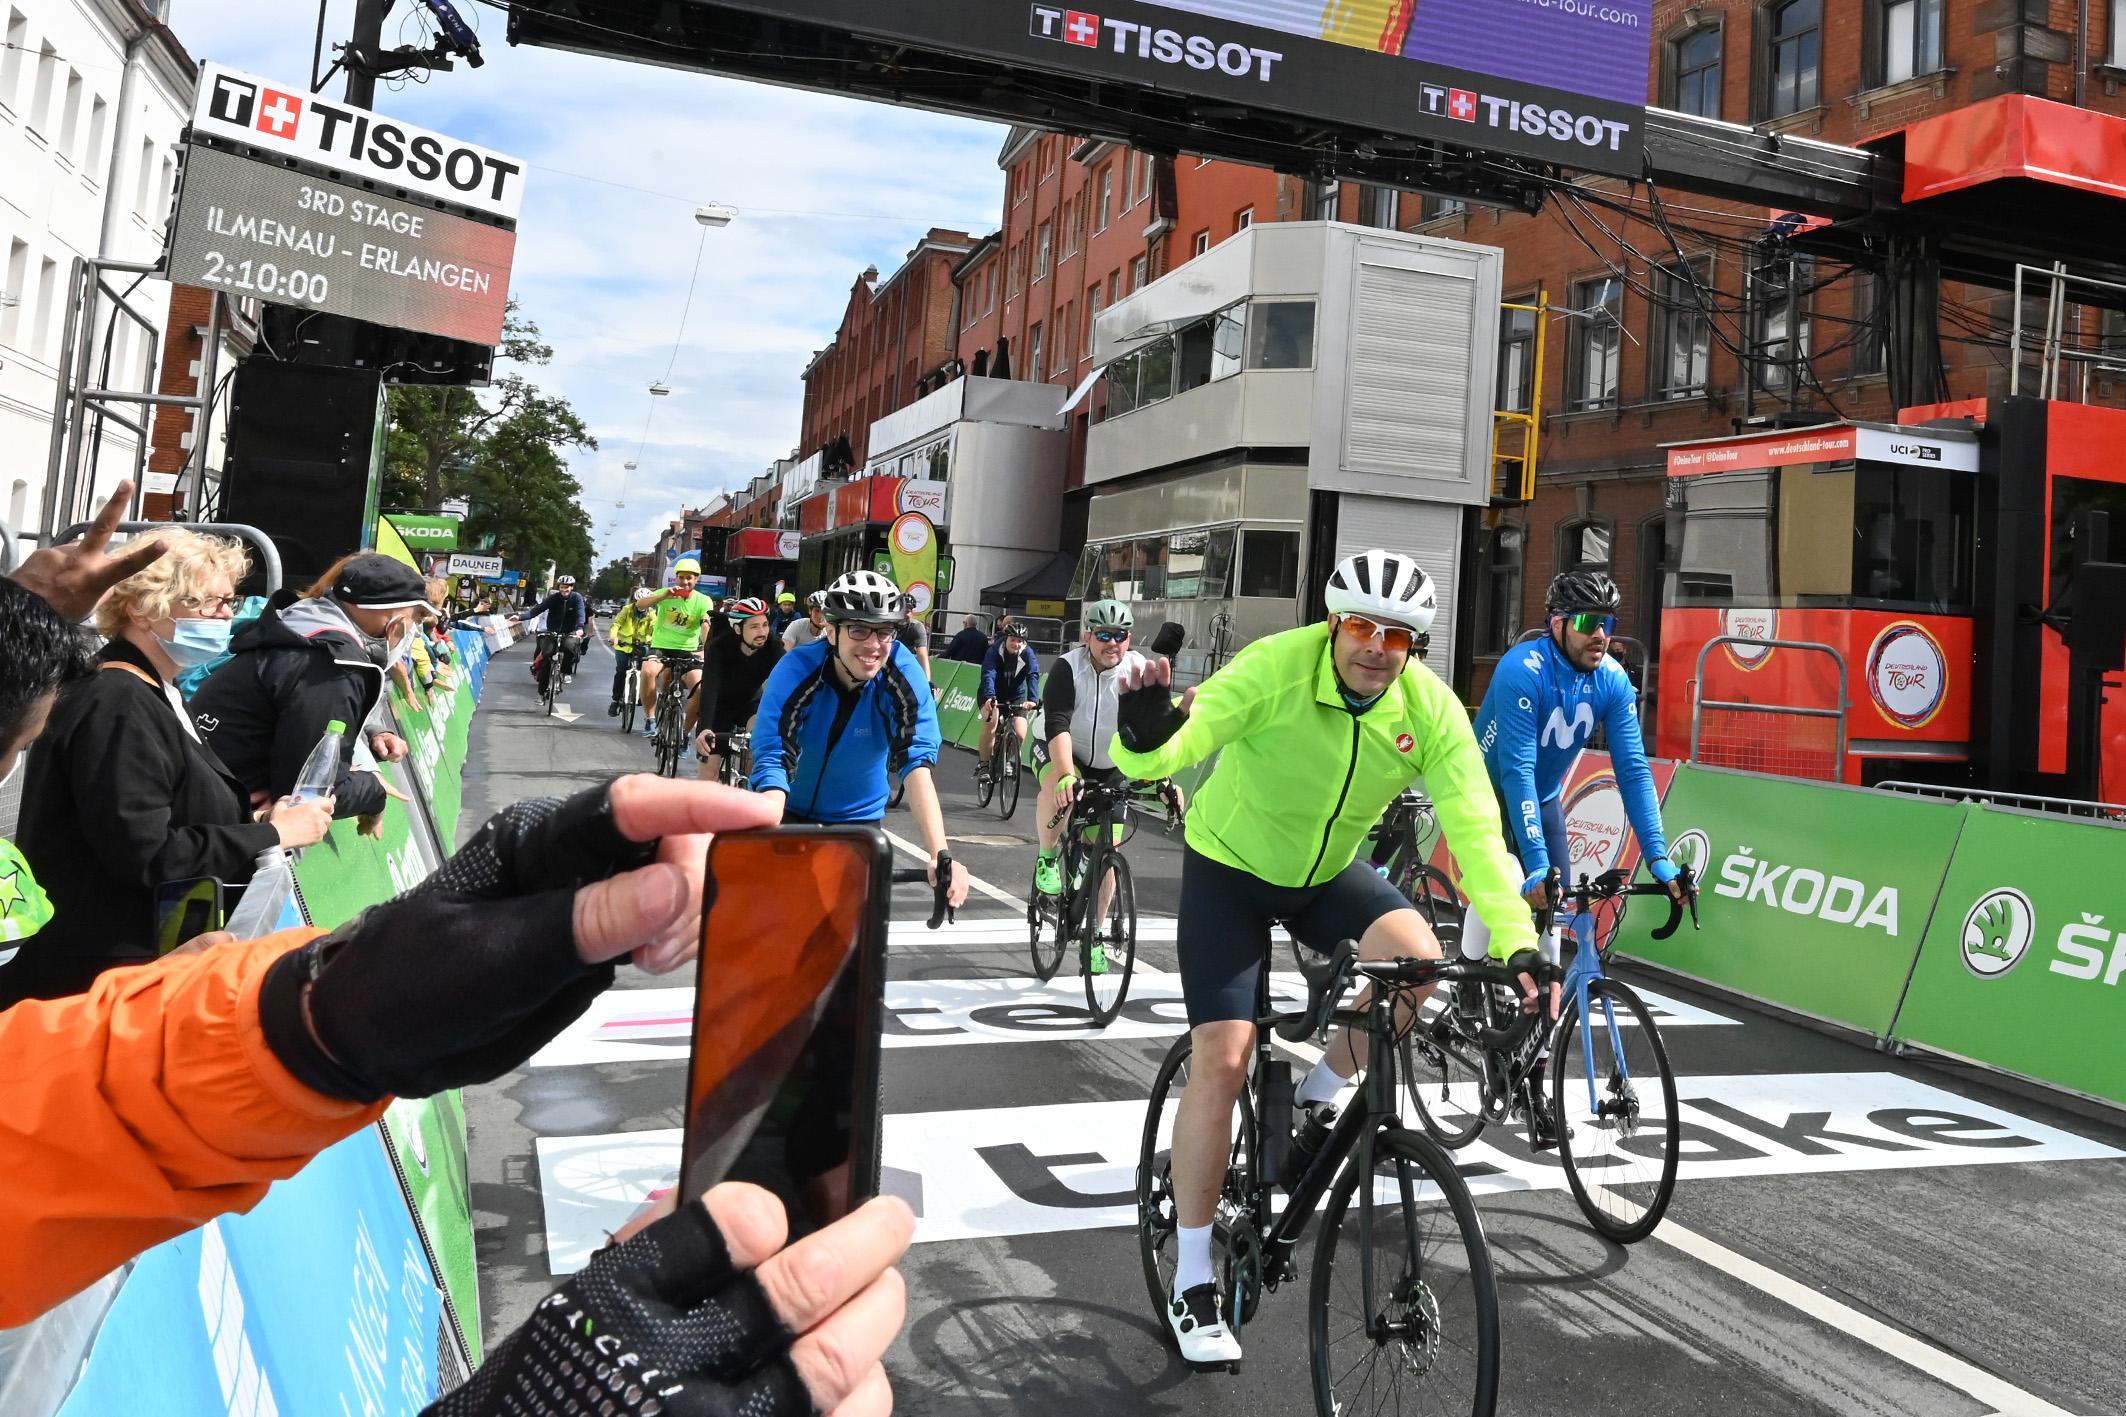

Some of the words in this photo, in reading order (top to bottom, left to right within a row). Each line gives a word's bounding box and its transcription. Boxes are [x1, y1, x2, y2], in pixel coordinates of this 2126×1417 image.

[1103, 18, 1283, 82] TISSOT
[1480, 98, 1630, 151] TISSOT
[310, 101, 520, 201] TISSOT
[297, 186, 345, 217] 3RD
[350, 200, 424, 239] STAGE
[207, 206, 336, 258] ILMENAU
[360, 243, 490, 295] ERLANGEN
[201, 251, 328, 303] 2:10:00
[1767, 438, 1849, 456] www.deutschland-tour.com
[1890, 444, 1908, 455] UCI
[1737, 624, 1765, 639] TOUR
[1888, 671, 1926, 691] TOUR
[1567, 818, 1620, 835] DEUTSCHLAND
[1567, 831, 1611, 867] TOUR
[1715, 846, 1898, 936] ŠKODA
